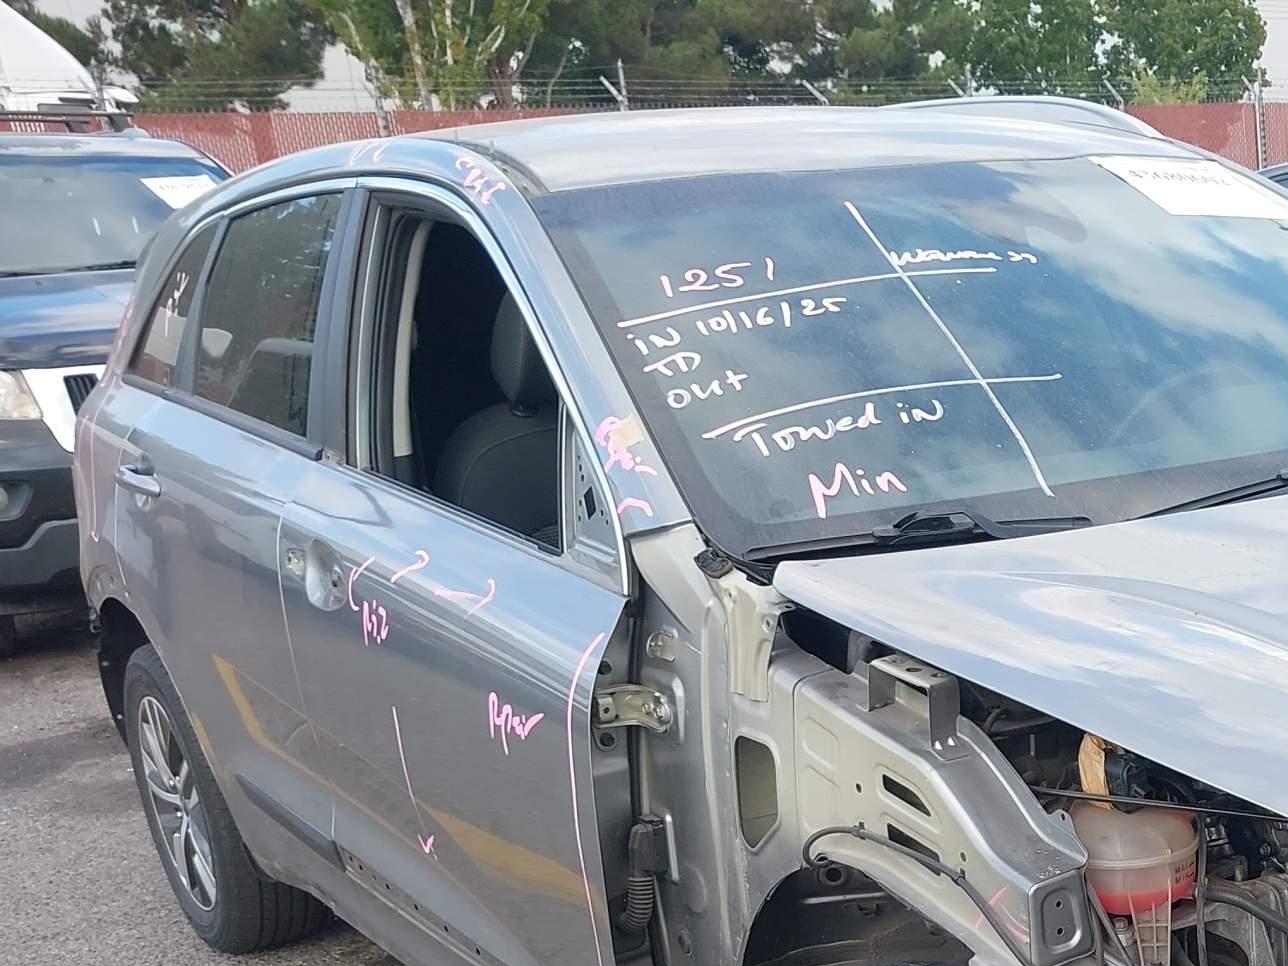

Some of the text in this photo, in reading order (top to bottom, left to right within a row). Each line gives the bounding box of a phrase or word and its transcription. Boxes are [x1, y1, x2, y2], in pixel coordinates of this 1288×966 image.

[660, 257, 774, 297] 1251
[696, 297, 848, 336] 10/16/25
[808, 462, 908, 519] Min
